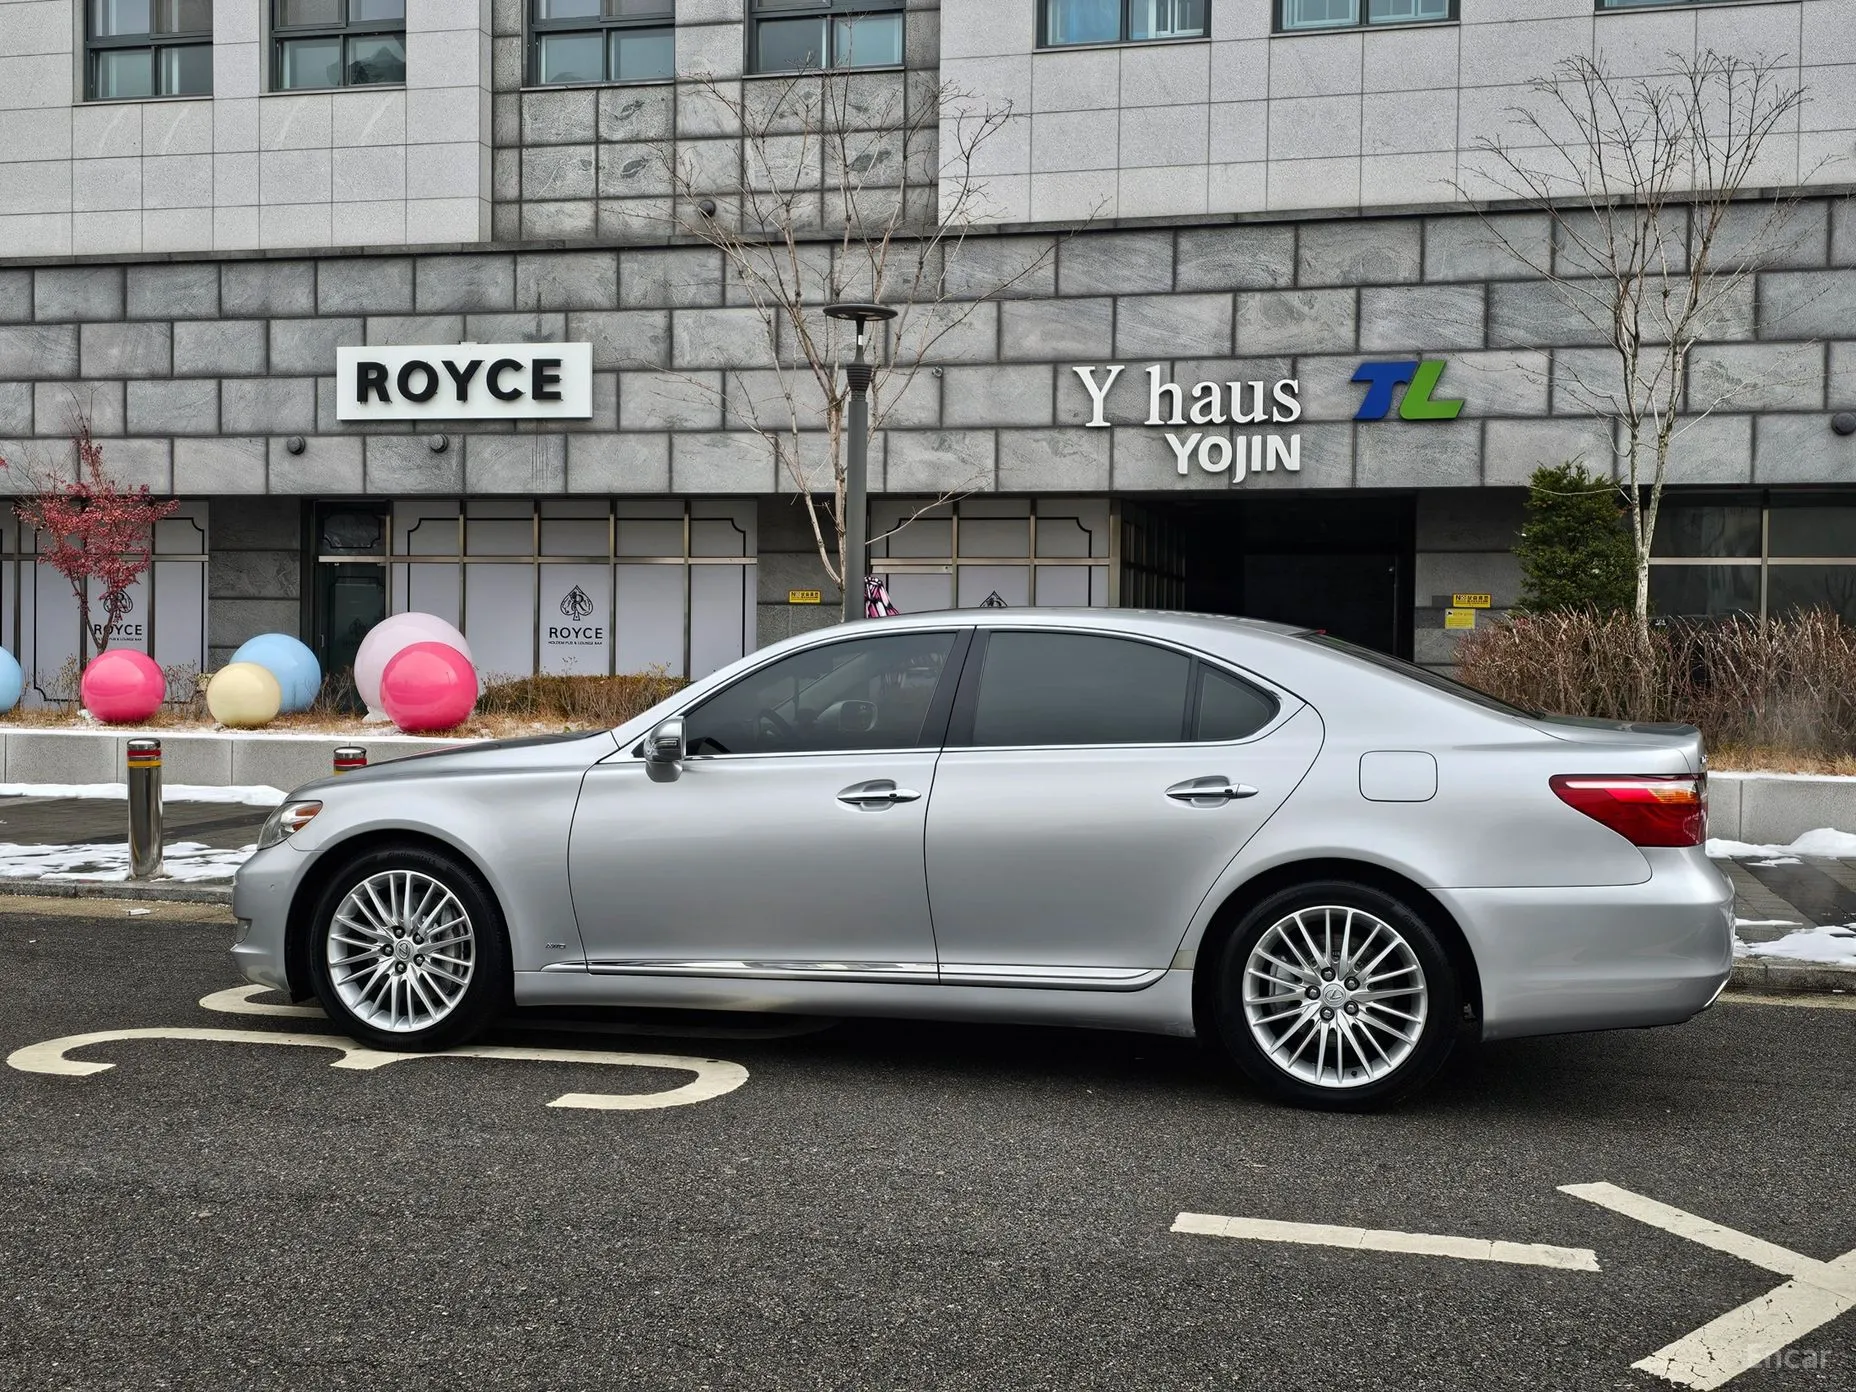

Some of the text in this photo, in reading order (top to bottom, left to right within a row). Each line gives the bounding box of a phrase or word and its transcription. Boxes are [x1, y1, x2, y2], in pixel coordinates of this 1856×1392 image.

[356, 358, 563, 404] ROYCE
[1073, 364, 1302, 427] Y haus
[1165, 433, 1300, 483] YOJIN
[549, 627, 603, 639] ROYCE
